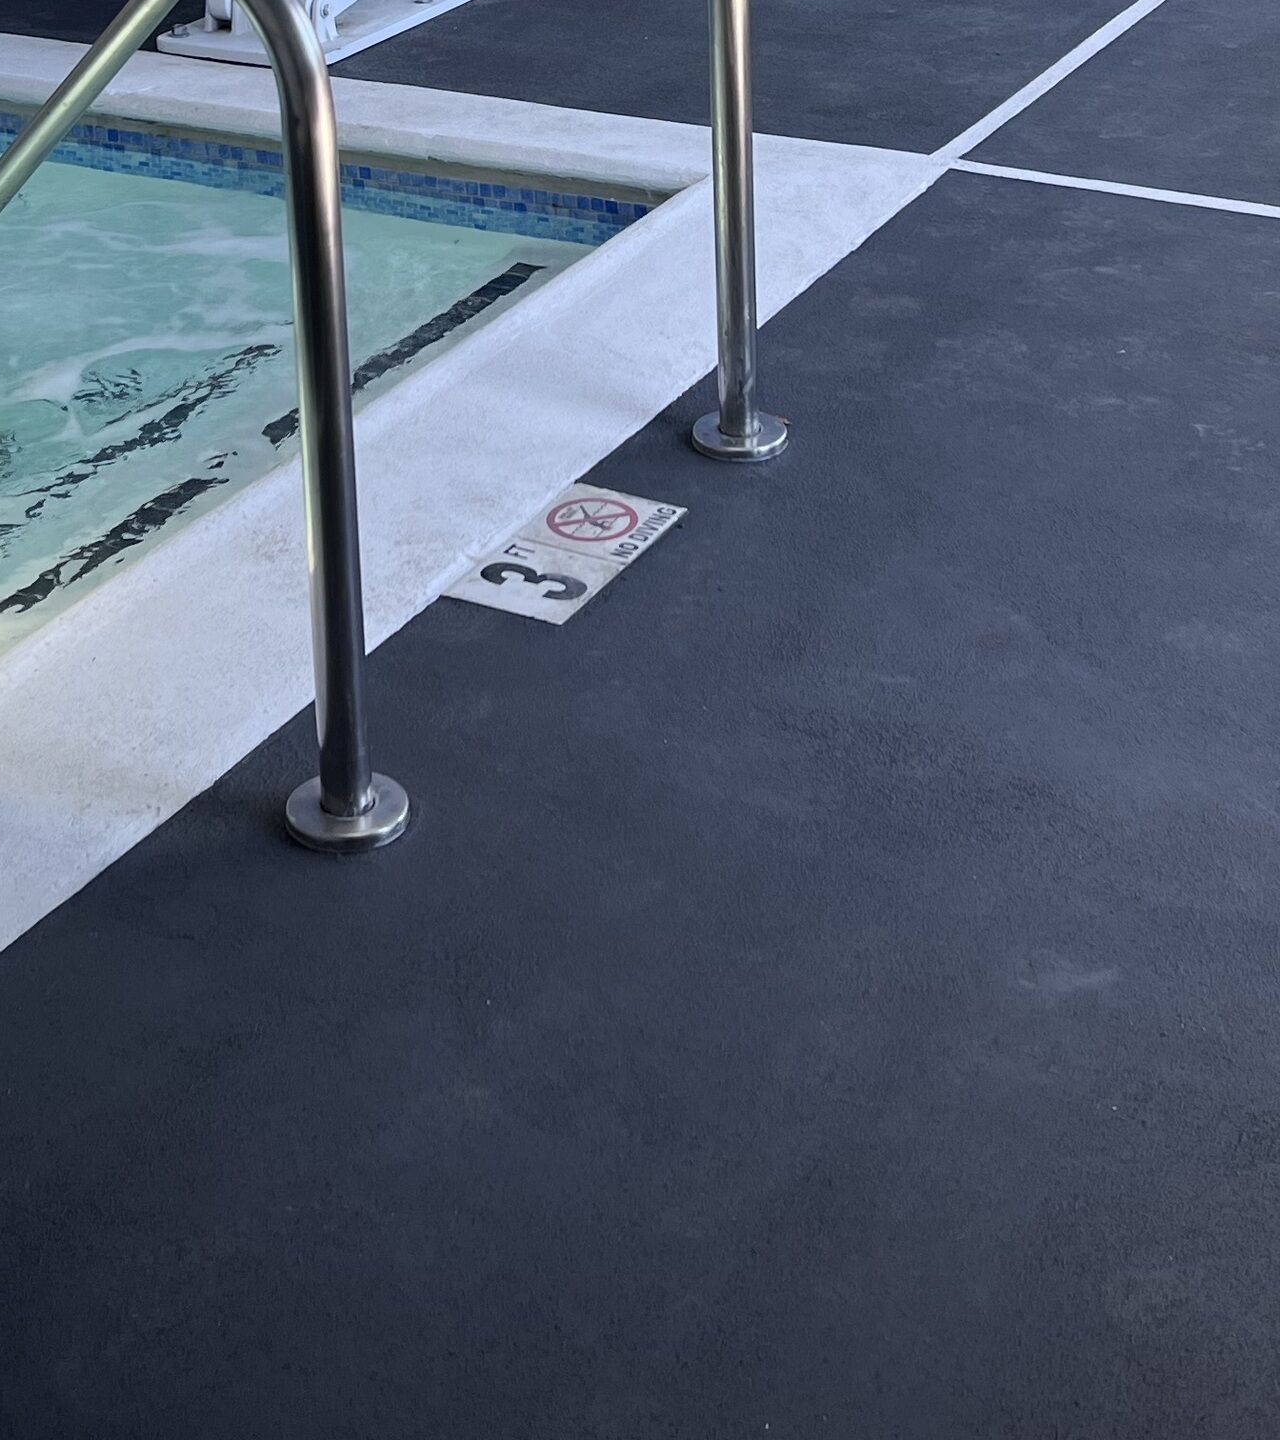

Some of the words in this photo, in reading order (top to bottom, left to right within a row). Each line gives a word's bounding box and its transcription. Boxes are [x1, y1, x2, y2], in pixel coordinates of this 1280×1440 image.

[503, 544, 535, 560] FT
[609, 542, 639, 559] NO
[628, 507, 677, 542] DIVING
[480, 562, 588, 600] 3
